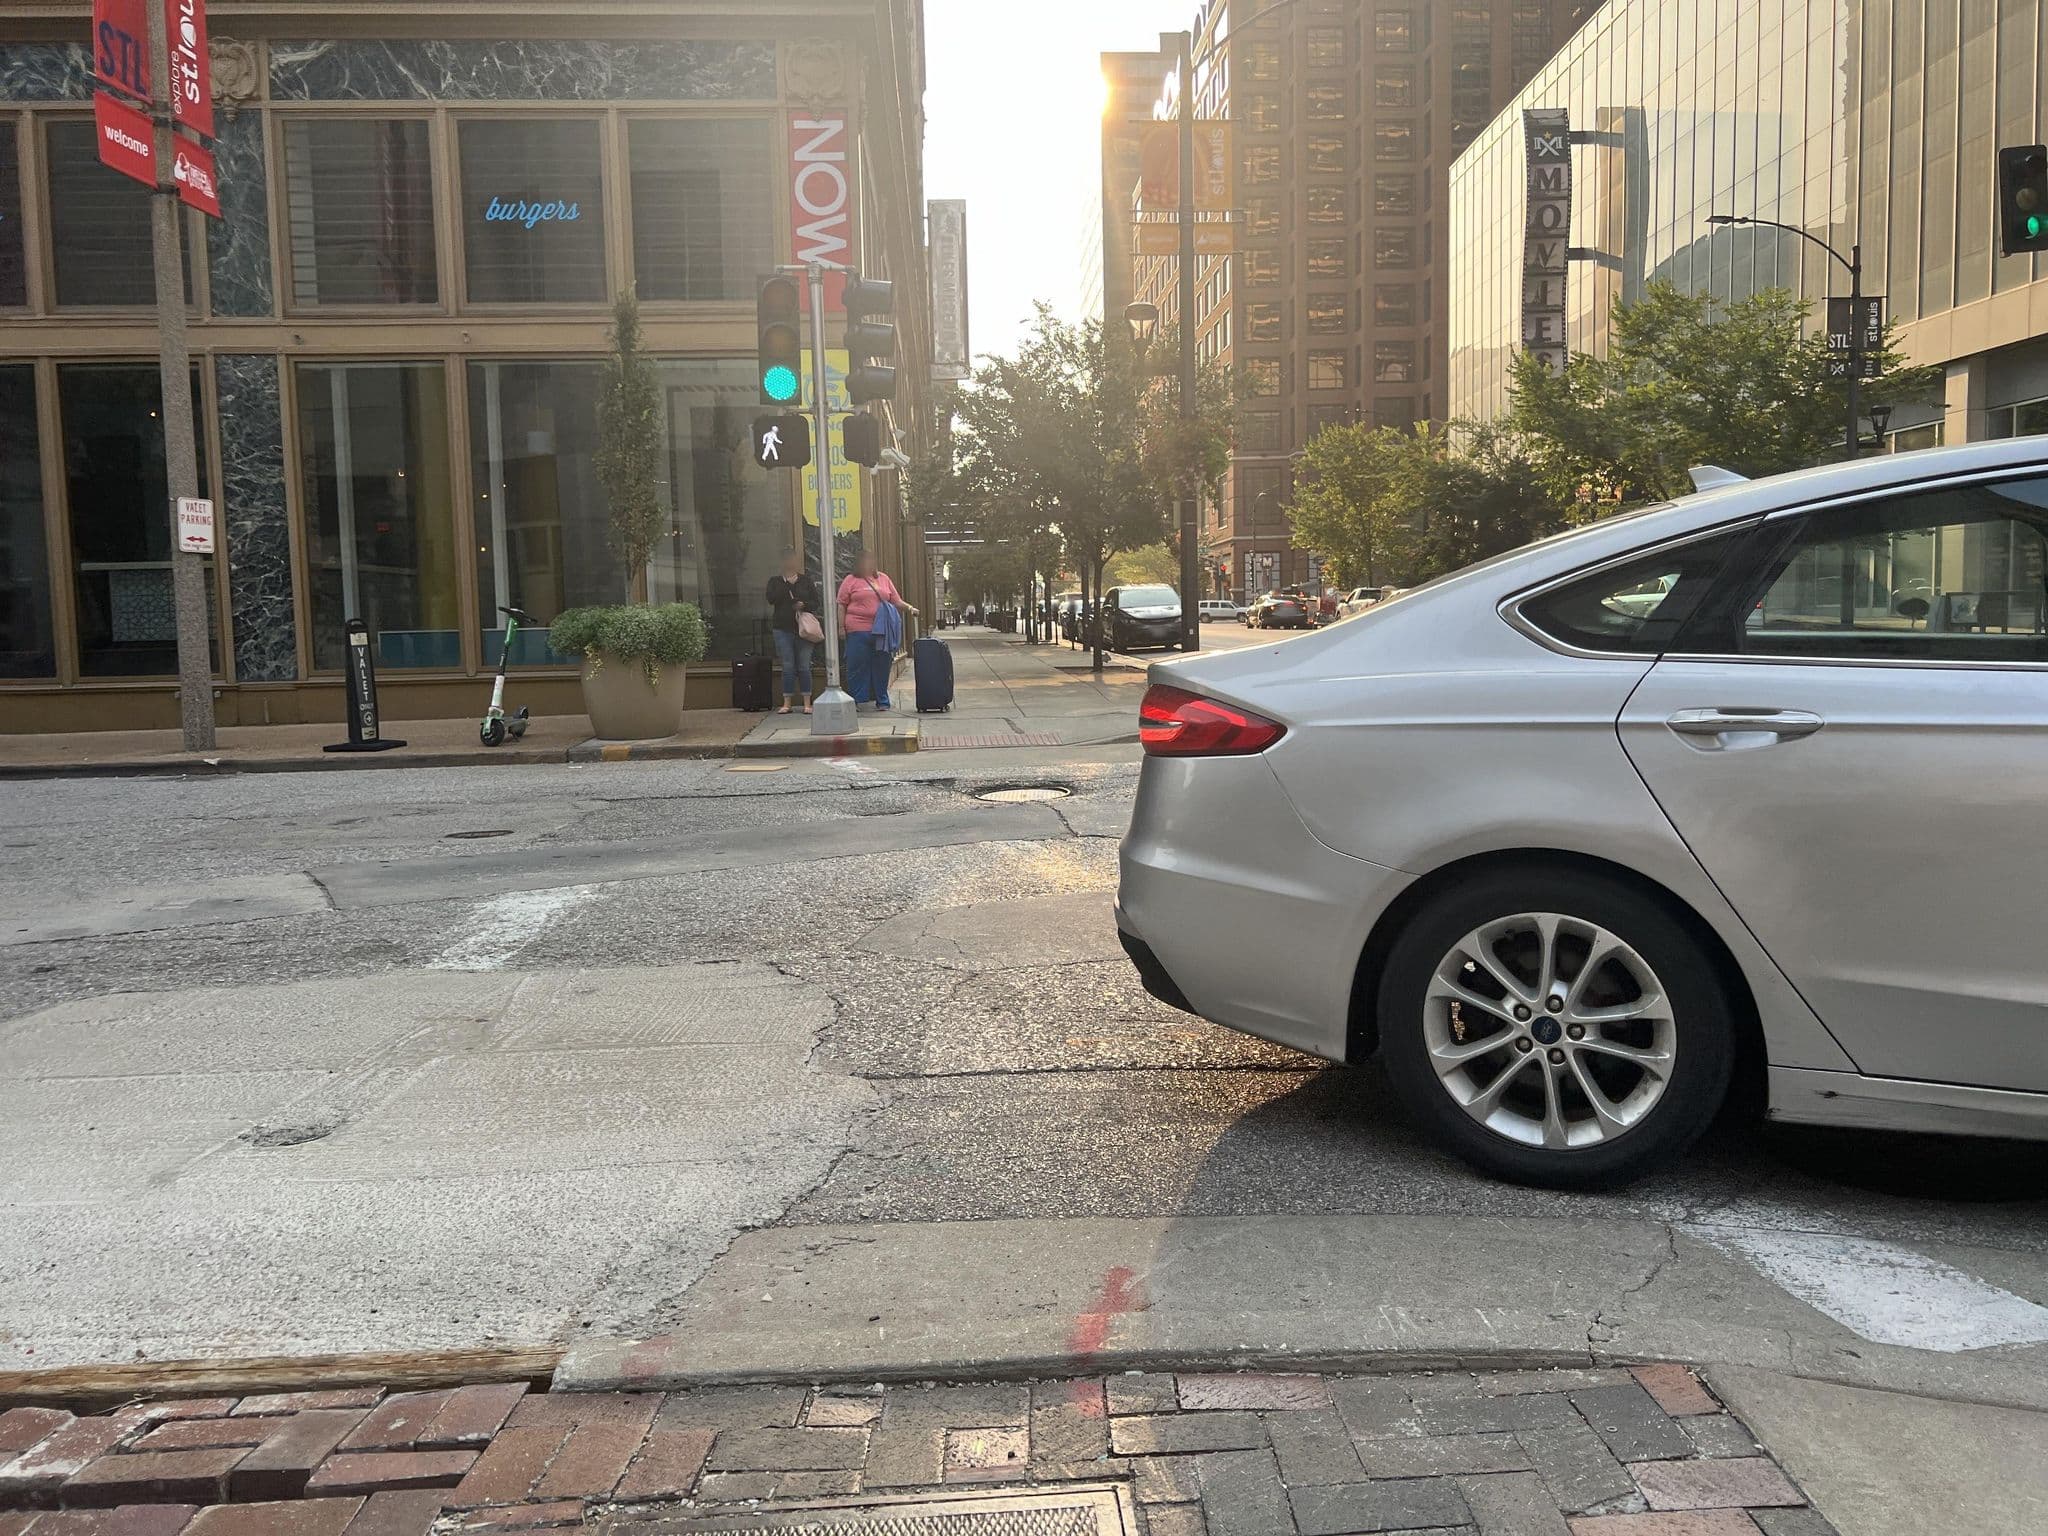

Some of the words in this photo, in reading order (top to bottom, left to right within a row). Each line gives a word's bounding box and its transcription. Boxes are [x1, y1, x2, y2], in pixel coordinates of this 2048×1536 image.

[99, 20, 147, 96] STL
[171, 51, 182, 114] explore
[104, 125, 149, 157] welcome
[485, 197, 580, 229] burgers
[793, 120, 847, 274] NOW
[1829, 334, 1849, 348] STL
[810, 445, 848, 467] TOS
[180, 513, 212, 525] PARKING
[185, 502, 206, 513] VALET
[357, 647, 369, 701] VALET
